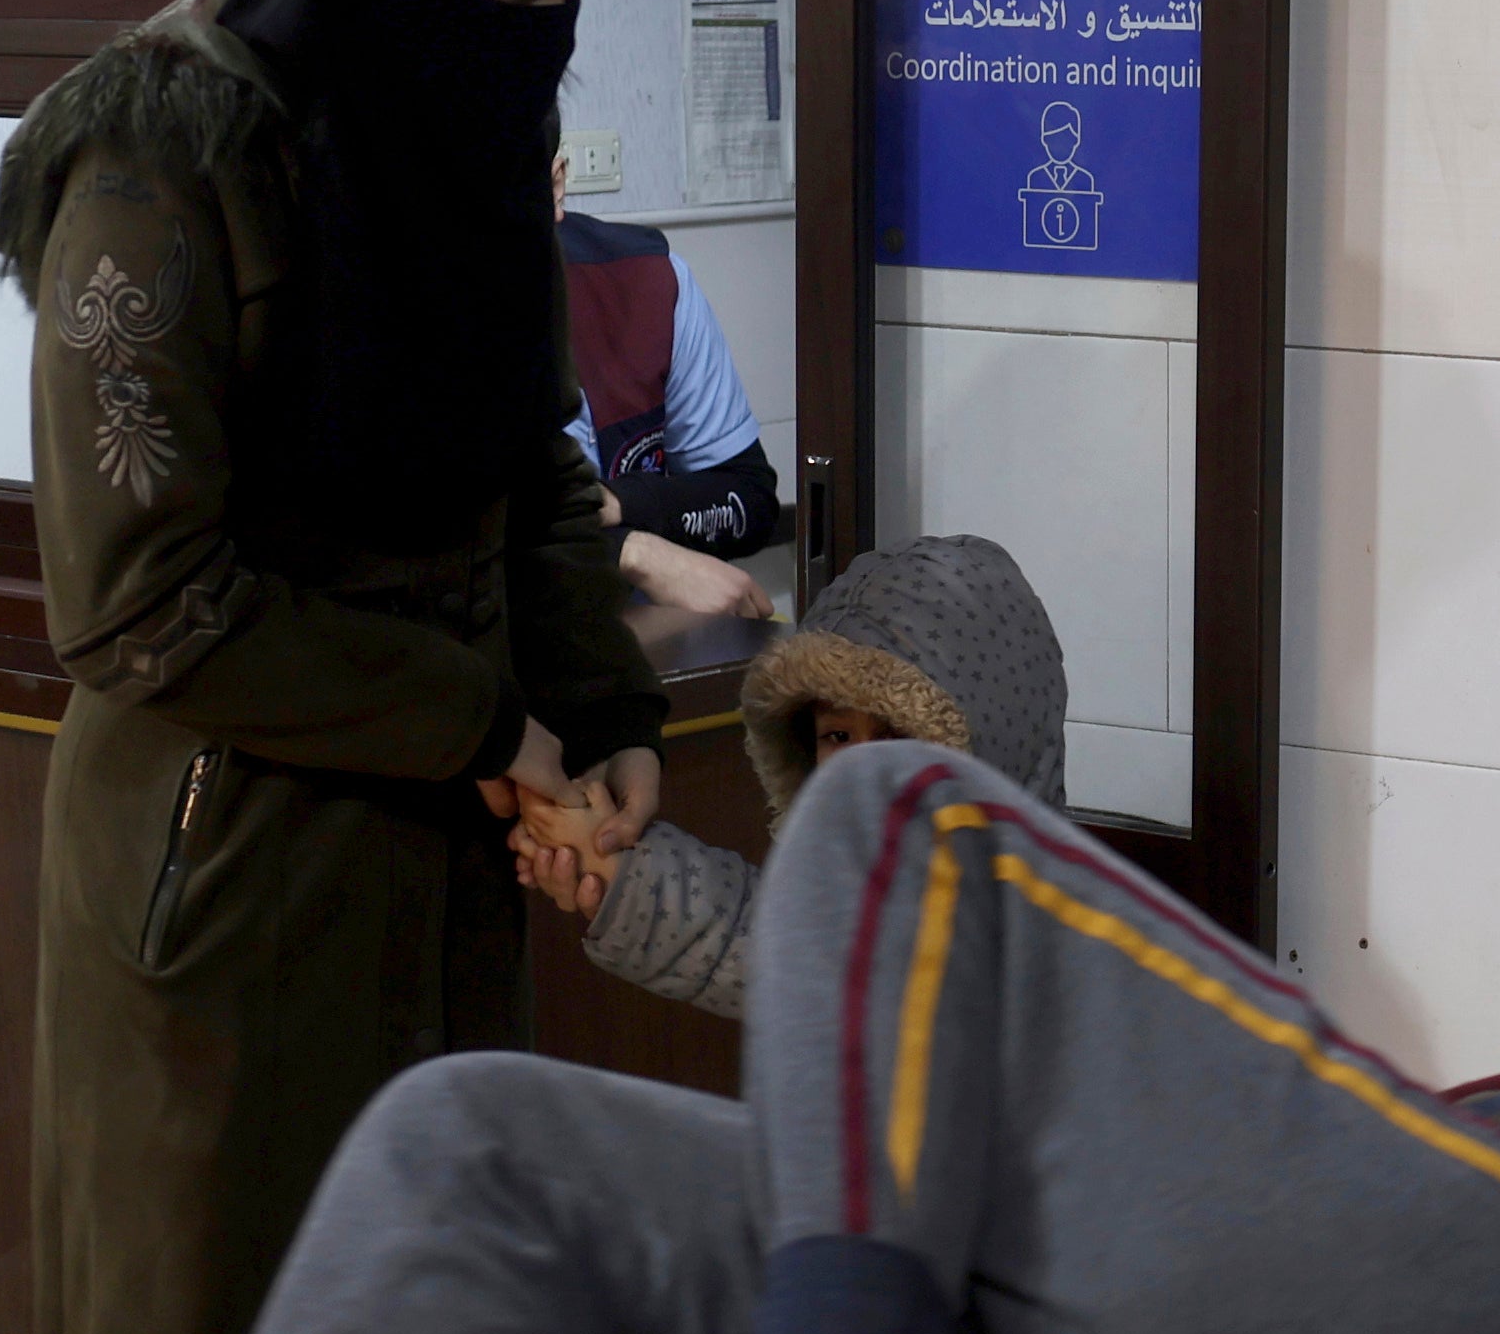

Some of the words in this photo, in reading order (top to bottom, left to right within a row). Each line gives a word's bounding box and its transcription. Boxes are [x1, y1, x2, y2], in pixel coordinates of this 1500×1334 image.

[1078, 10, 1096, 39] و
[887, 51, 1057, 84] Coordination
[1066, 55, 1116, 86] and
